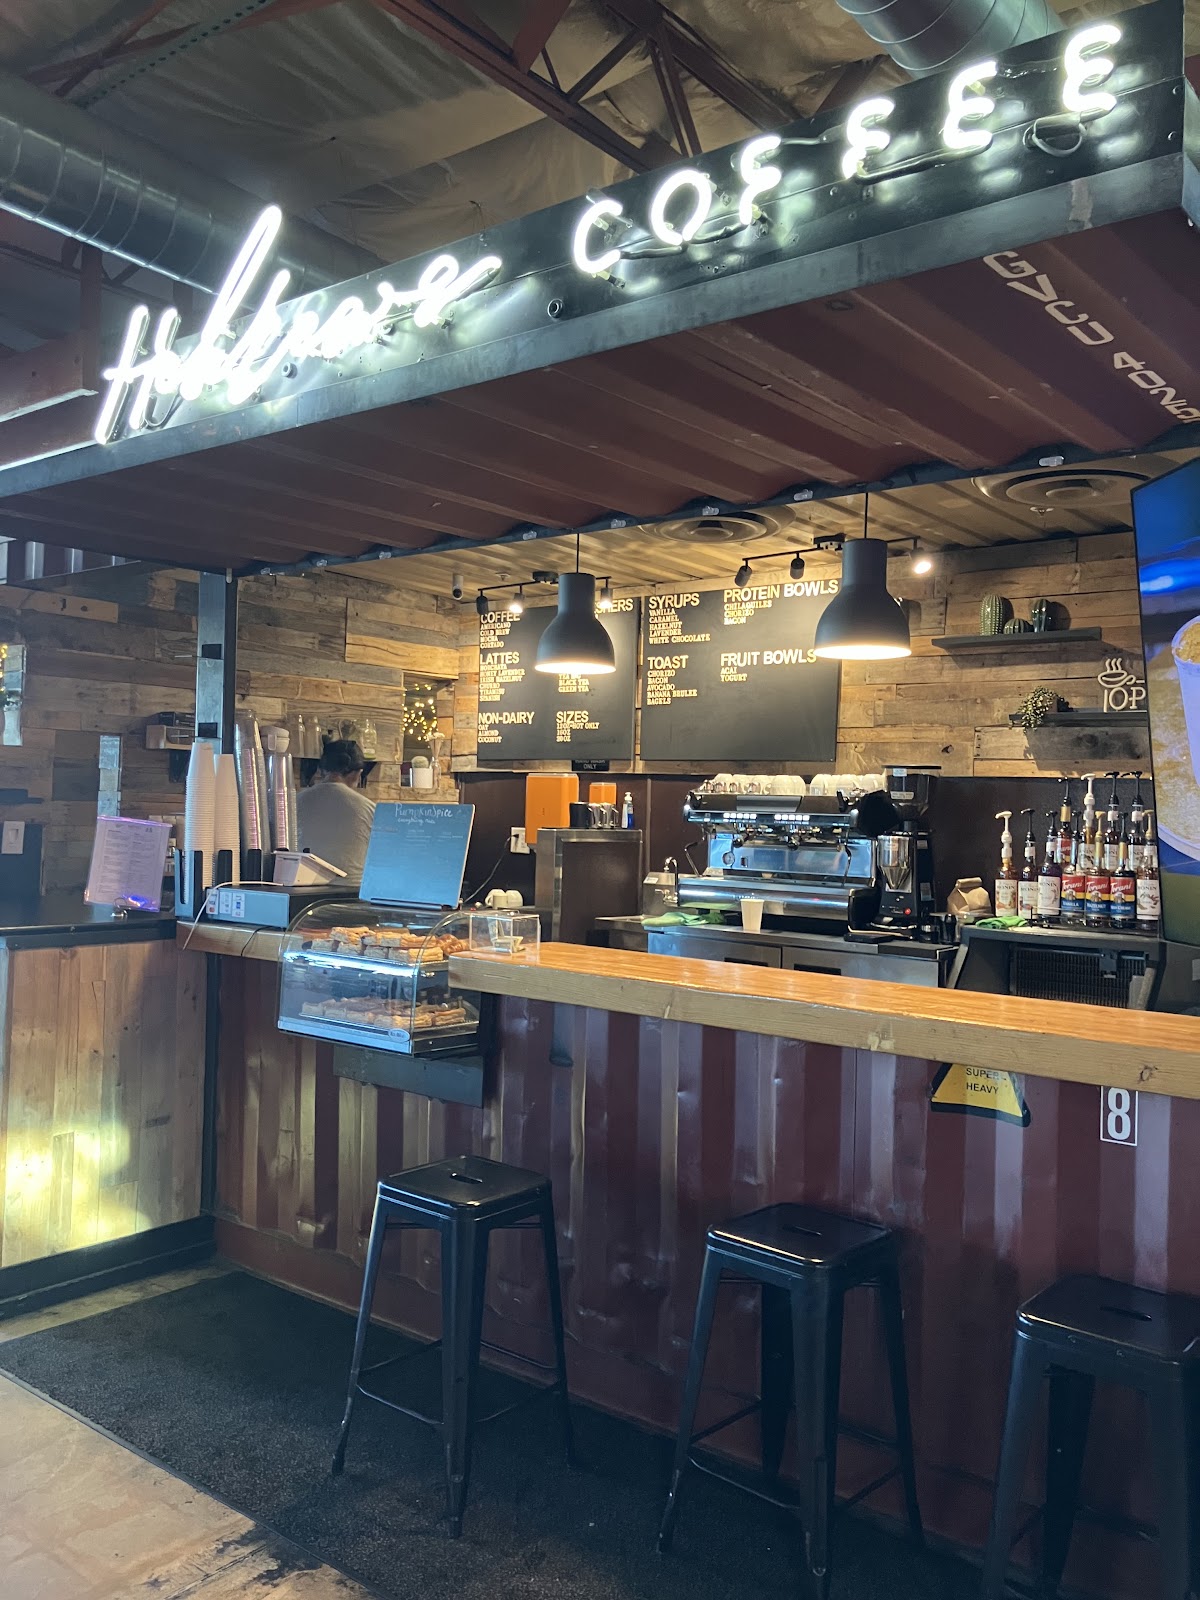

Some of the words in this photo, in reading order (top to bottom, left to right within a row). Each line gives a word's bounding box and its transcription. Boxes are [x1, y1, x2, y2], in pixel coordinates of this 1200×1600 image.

[573, 24, 1123, 273] COFFEE
[983, 251, 1114, 345] GVCU
[1113, 352, 1200, 424] 4025
[724, 585, 780, 602] PROTEIN
[784, 580, 838, 597] BOWLS
[649, 593, 700, 609] SYRUPS
[724, 600, 772, 610] CHILAQUILES
[480, 610, 520, 623] COFFEE
[649, 608, 676, 616] VANILLA
[724, 609, 754, 618] CHORIZO
[649, 615, 679, 623] CARAMEL
[724, 617, 746, 625] BACON
[650, 622, 682, 630] HAZELNUT
[650, 629, 681, 637] LAVENDER
[671, 634, 710, 643] CHOCOLATE
[480, 652, 520, 664] LATTES
[647, 655, 689, 669] TOAST
[721, 652, 760, 667] FRUIT
[763, 649, 817, 665] BOWLS
[720, 674, 747, 682] YOGURT
[672, 689, 697, 697] BRULEE
[478, 712, 535, 724] NON-DAIRY
[556, 711, 589, 723] SIZES
[1062, 880, 1083, 891] Torani
[1086, 881, 1108, 893] Torani
[1110, 881, 1132, 893] Torani
[966, 1082, 999, 1094] HEAVY
[1107, 1087, 1131, 1140] 8
